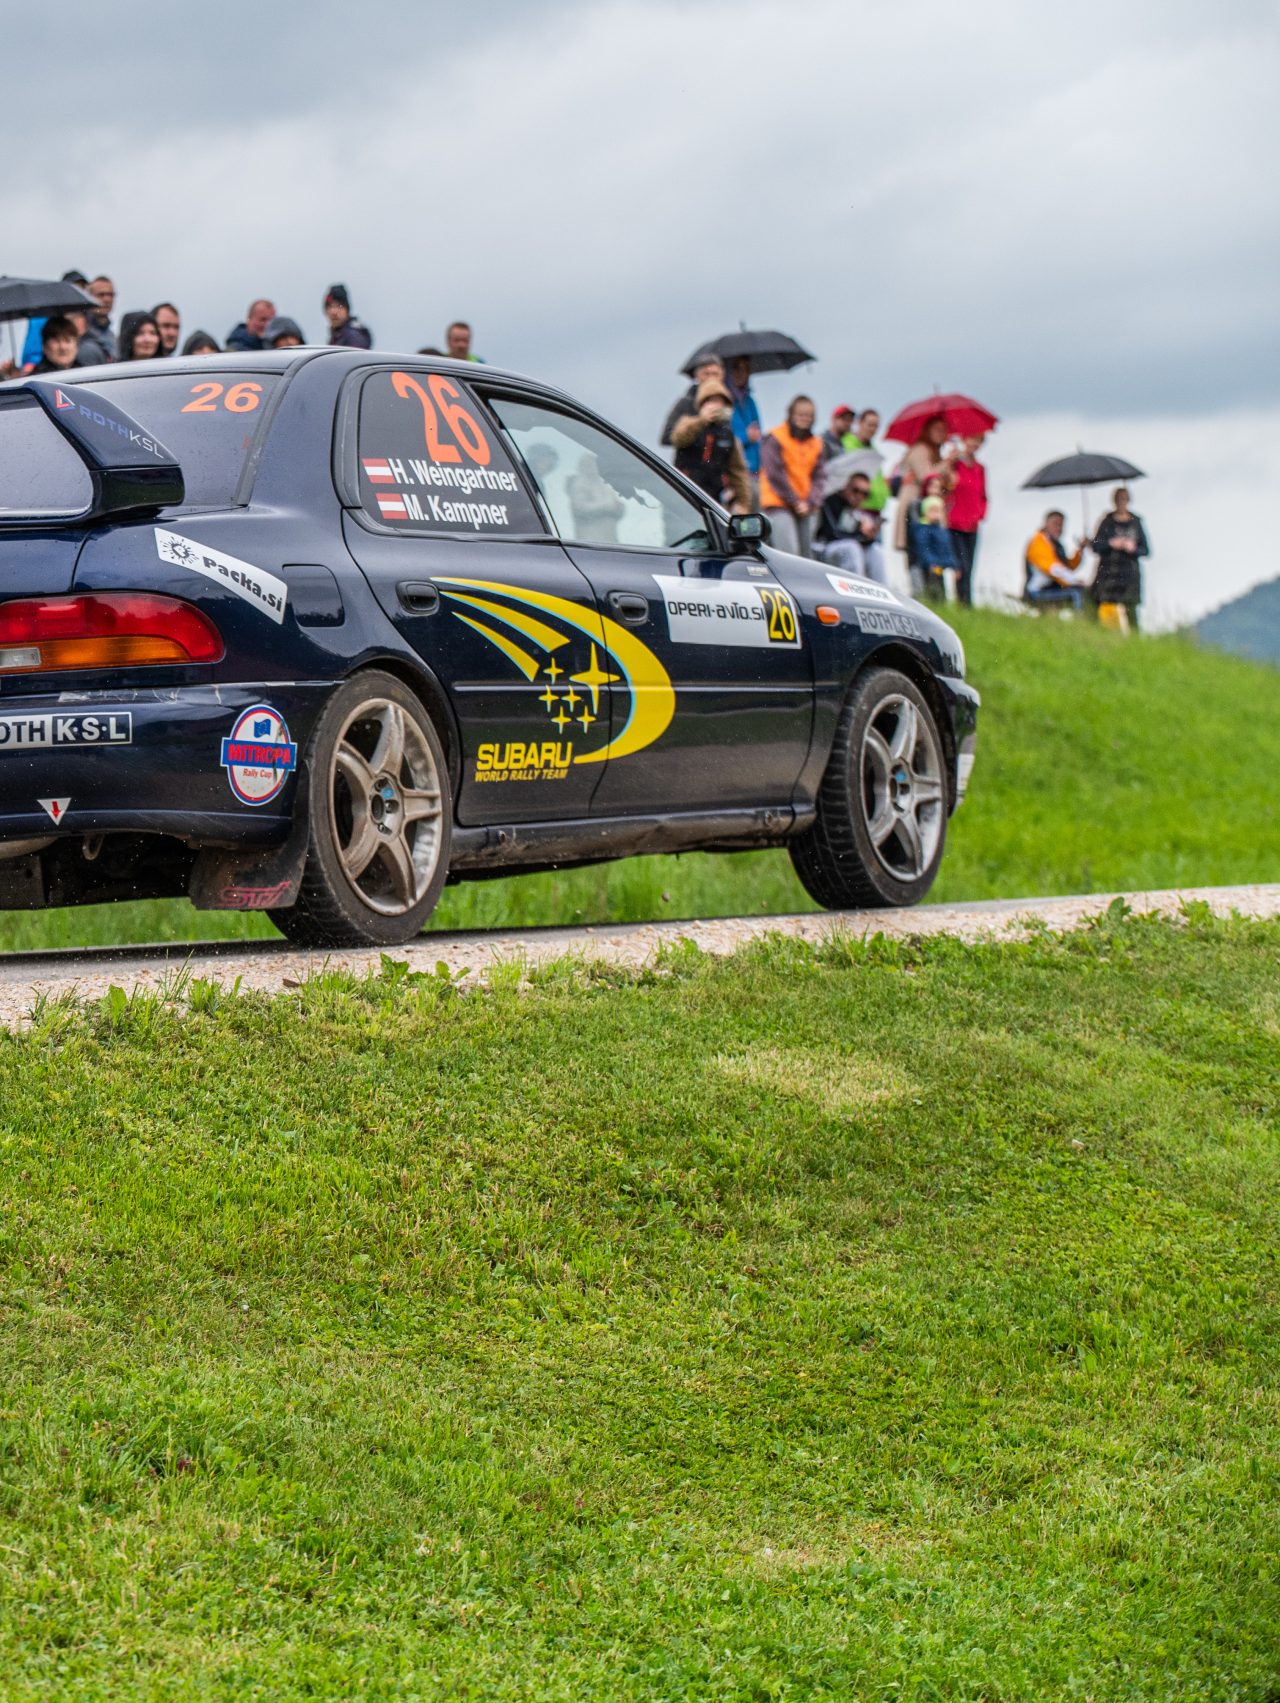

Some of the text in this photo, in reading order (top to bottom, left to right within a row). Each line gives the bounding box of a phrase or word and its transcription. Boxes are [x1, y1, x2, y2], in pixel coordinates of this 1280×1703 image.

[180, 382, 263, 413] 26
[391, 371, 491, 466] 26
[387, 457, 519, 495] H. Weingartner
[402, 493, 509, 531] M. Kampner
[760, 589, 796, 641] 26
[860, 611, 895, 633] ROTH
[227, 743, 292, 765] MITROPA
[476, 741, 573, 771] SUBARU
[242, 768, 274, 780] Rally Cup
[474, 768, 569, 783] WORLD RALLY TEAM
